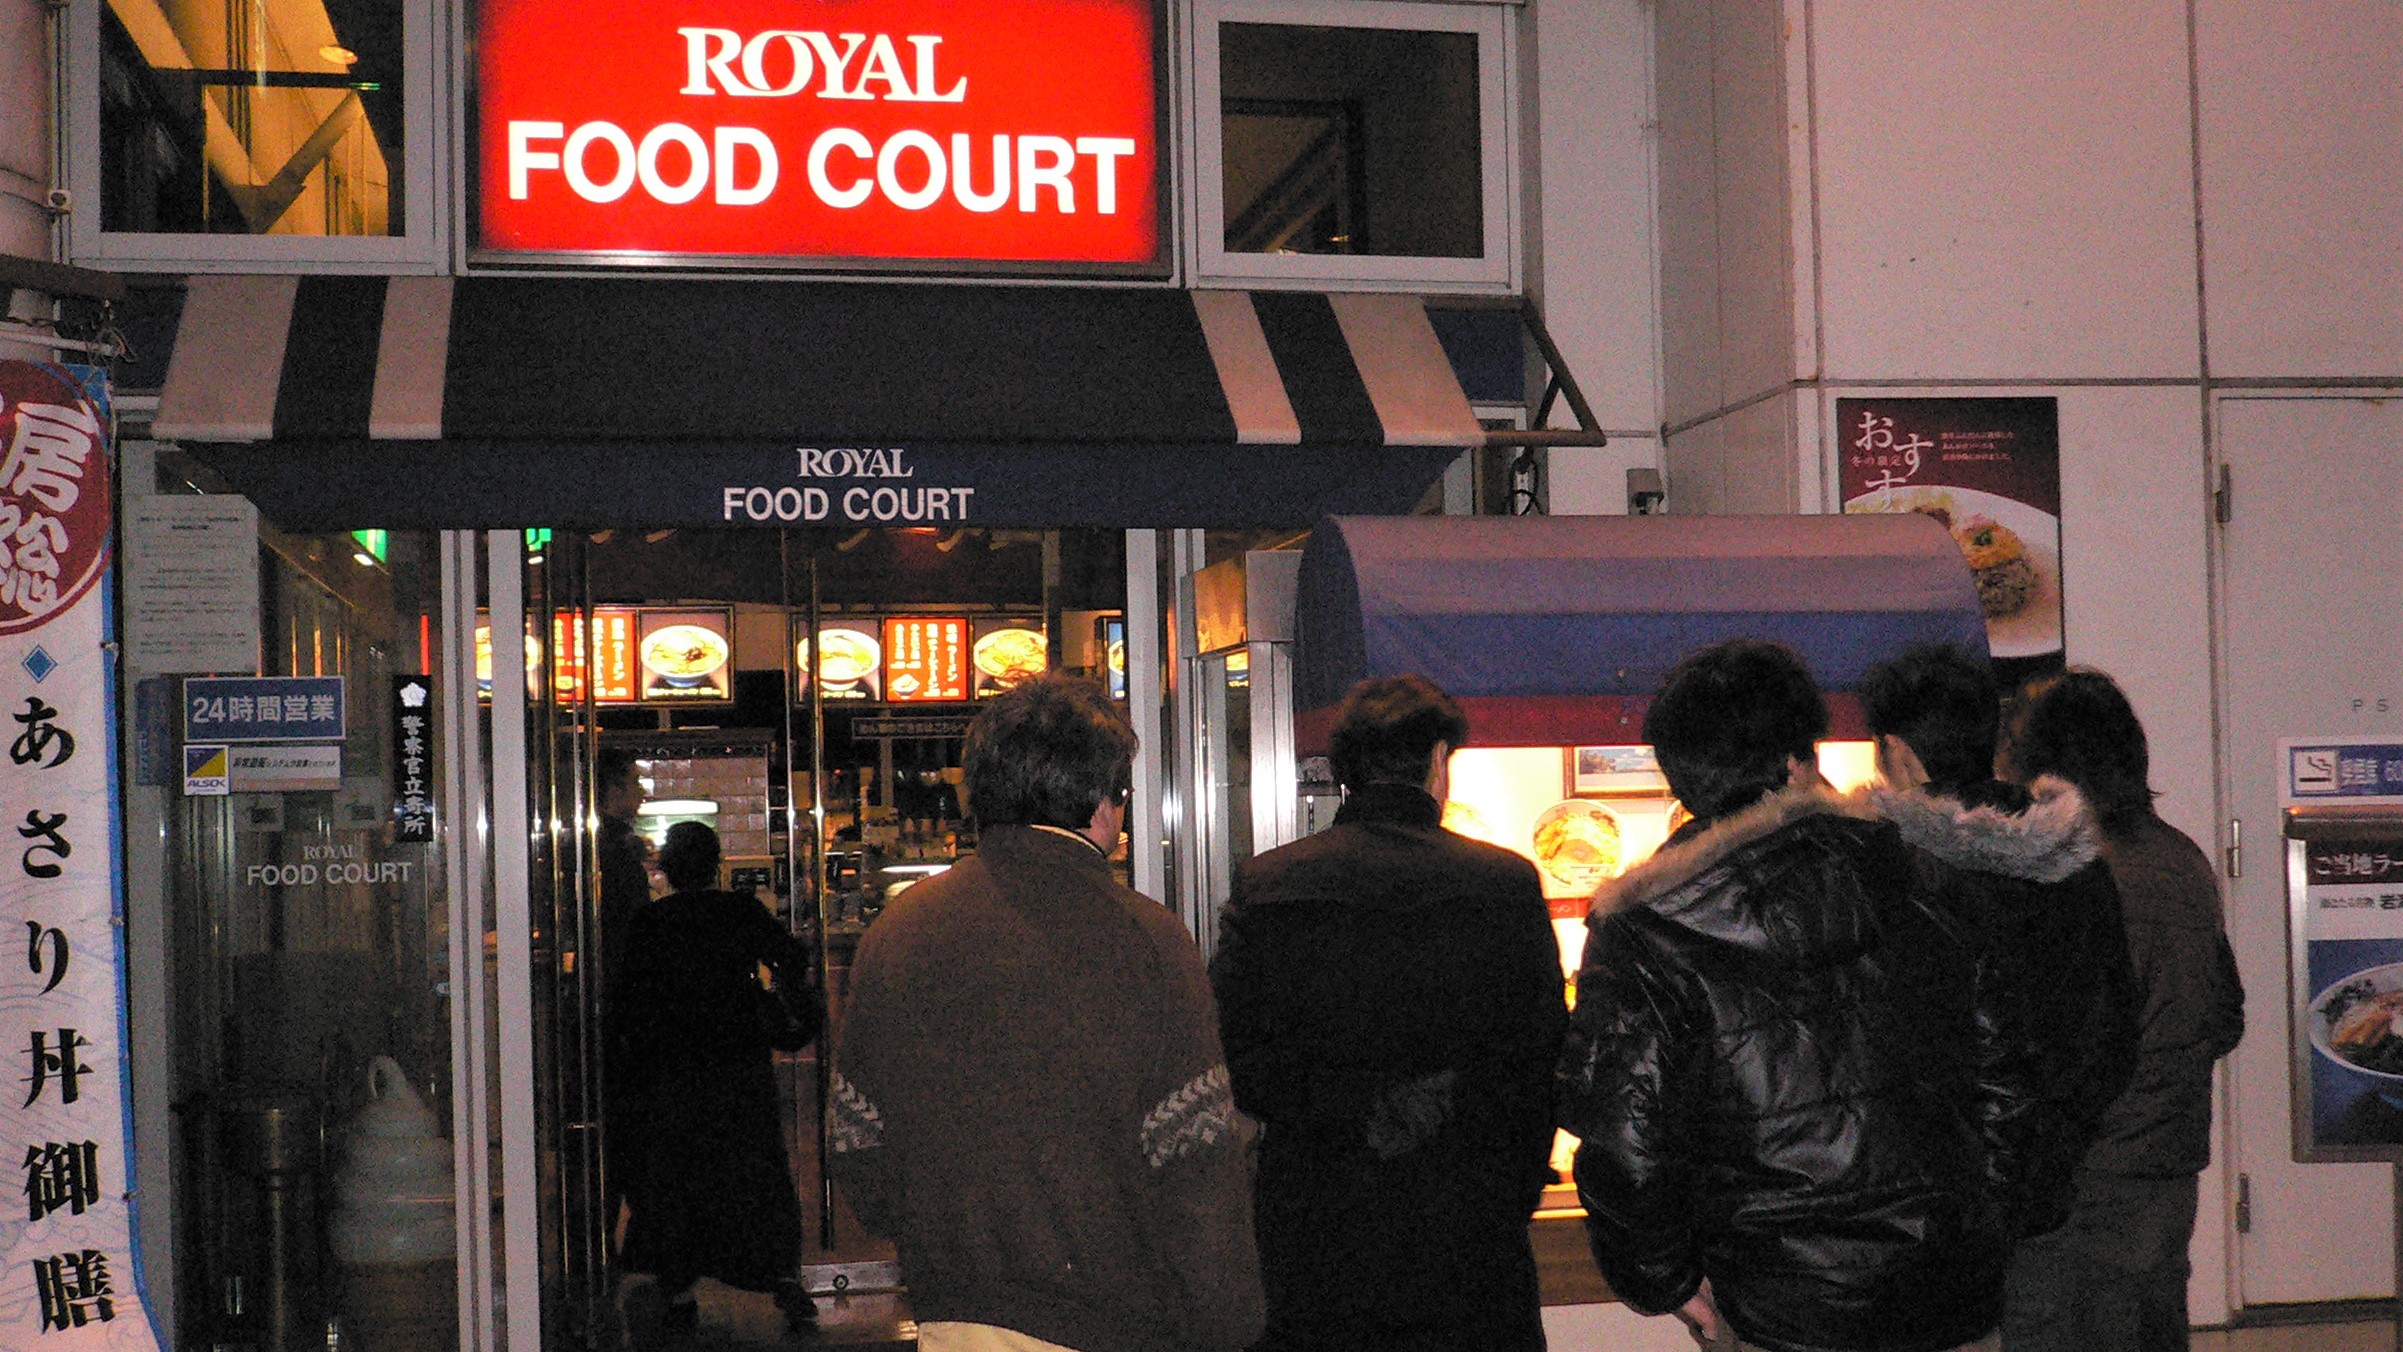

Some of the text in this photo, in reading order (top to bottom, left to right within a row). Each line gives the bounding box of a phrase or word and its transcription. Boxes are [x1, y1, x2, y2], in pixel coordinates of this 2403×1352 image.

[678, 27, 967, 103] ROYAL
[507, 120, 1136, 215] FOOD COURT
[797, 448, 914, 478] ROYAL
[724, 486, 975, 521] FOOD COURT
[192, 694, 336, 723] 24時間営業
[187, 778, 226, 788] ALSOK
[400, 715, 426, 836] 警察官立寄所
[247, 861, 413, 886] FOOD COURT
[9, 696, 115, 1334] あさり丼御膳
